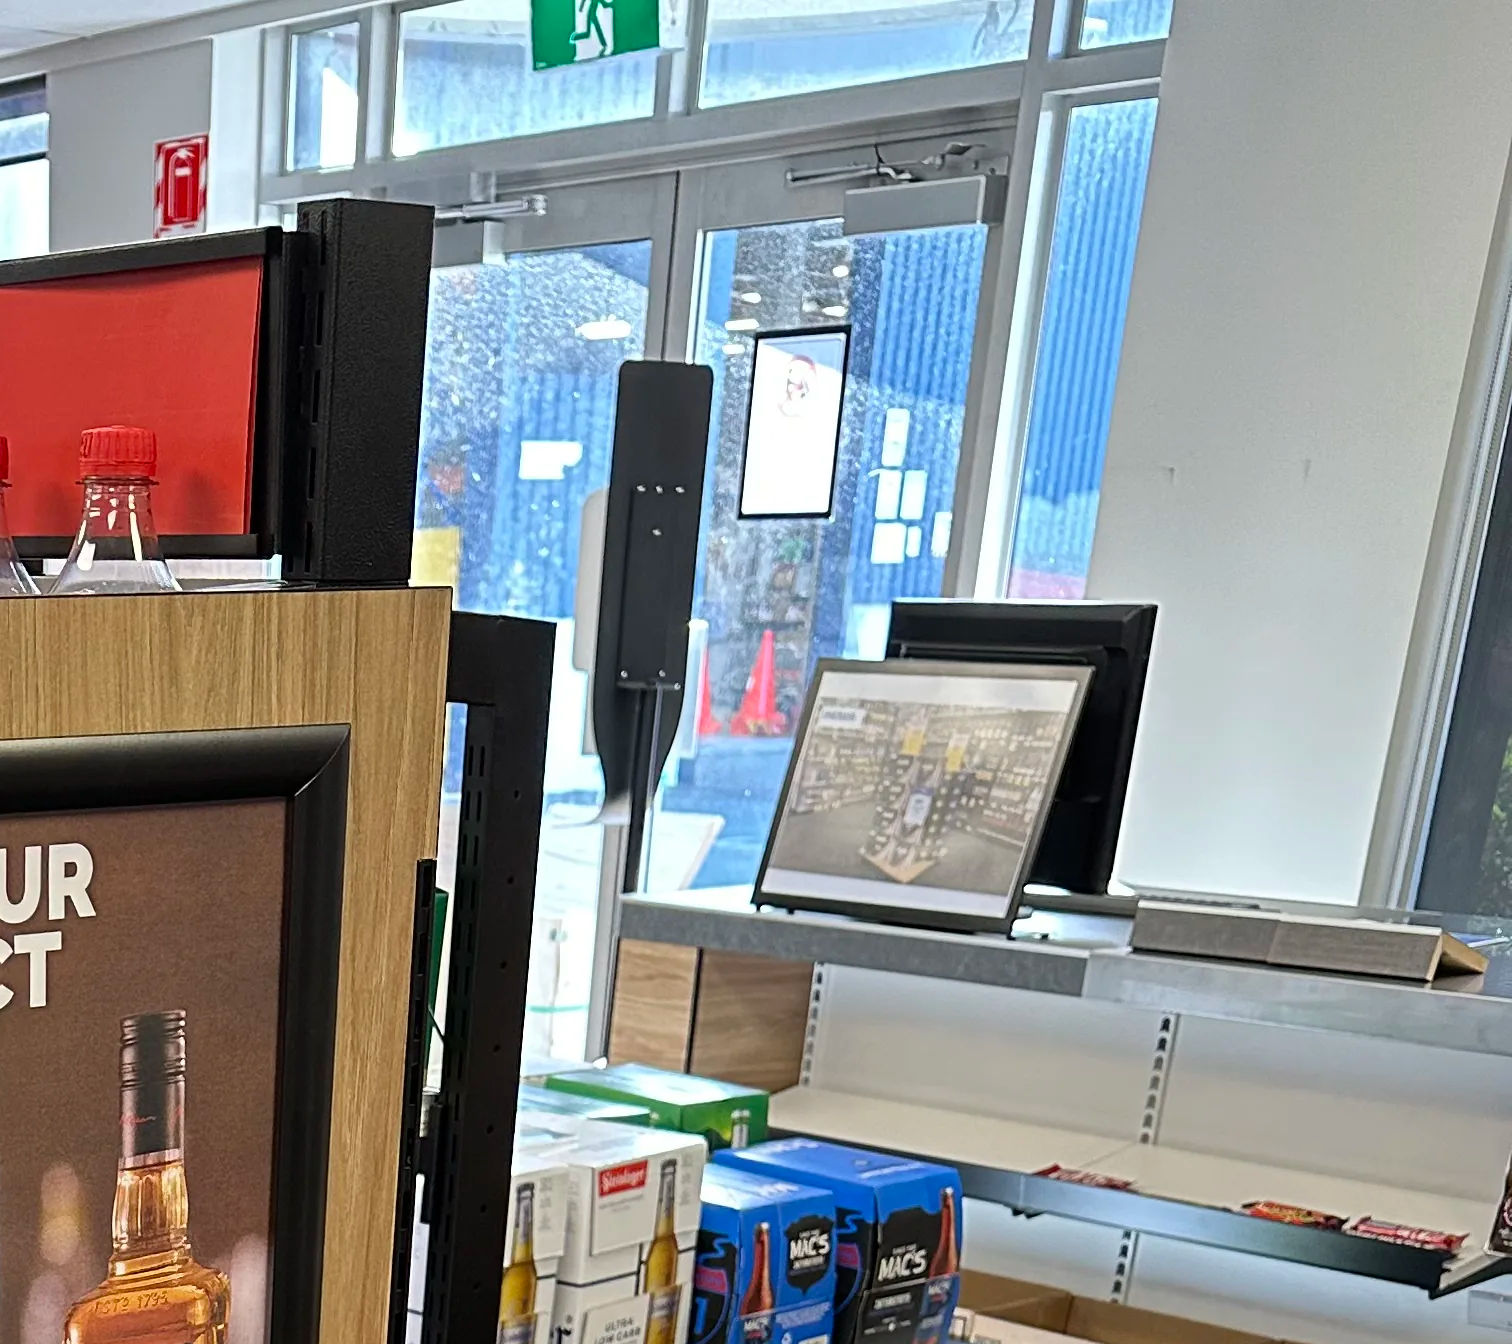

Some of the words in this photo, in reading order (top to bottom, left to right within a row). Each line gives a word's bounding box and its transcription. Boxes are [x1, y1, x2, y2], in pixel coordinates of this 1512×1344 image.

[790, 1232, 831, 1260] MAC'S
[878, 1249, 927, 1282] MAC'S
[605, 1317, 633, 1333] ULTRA
